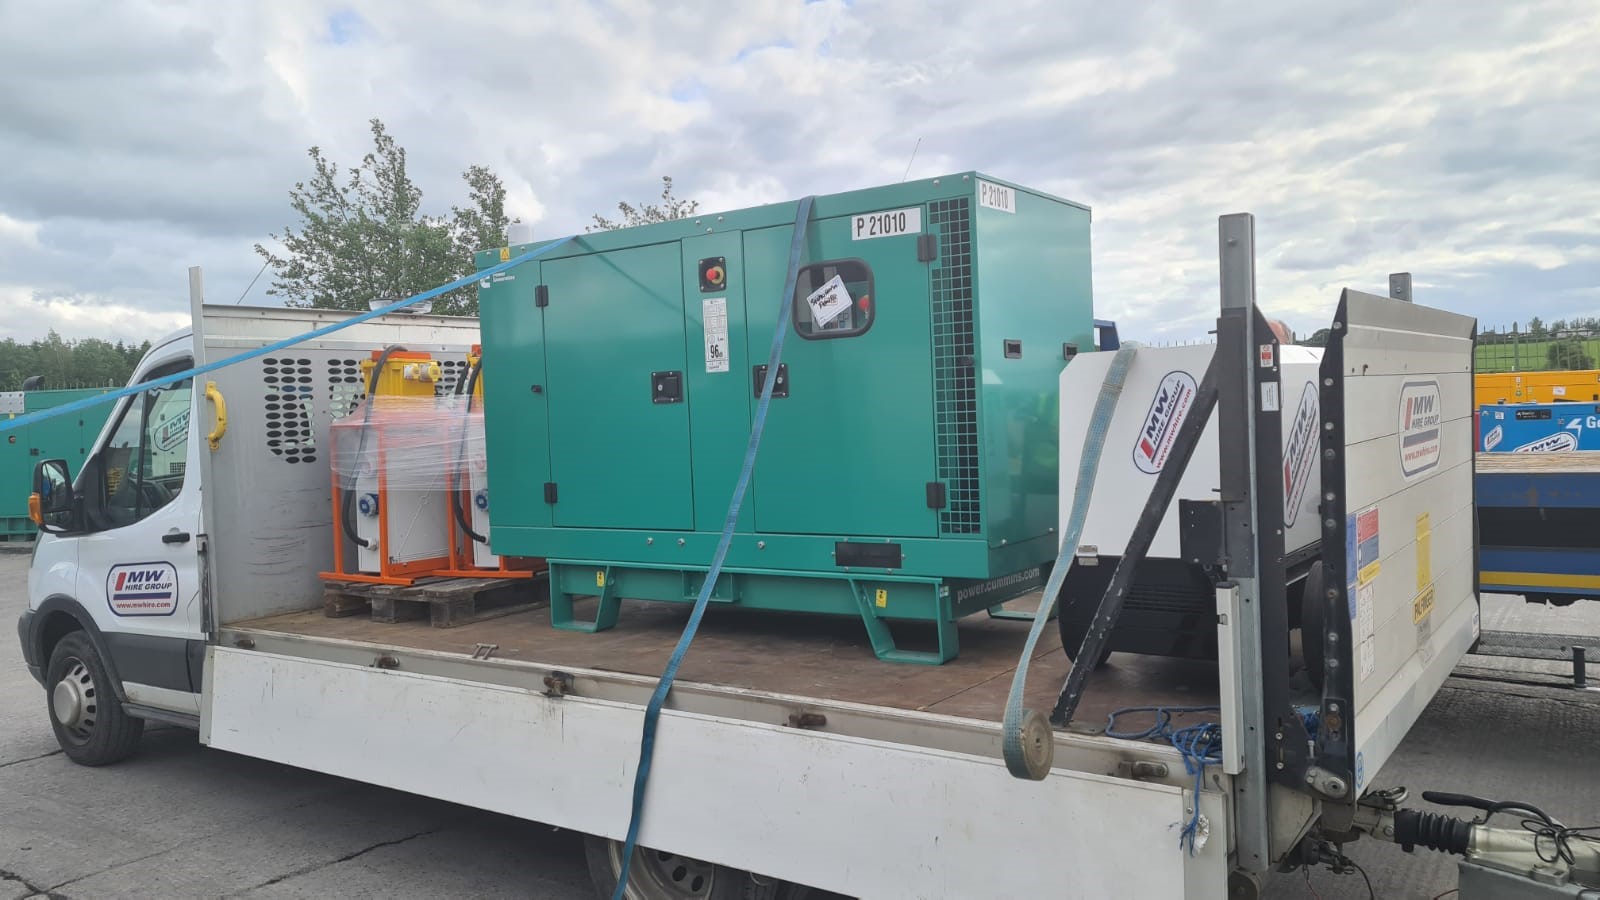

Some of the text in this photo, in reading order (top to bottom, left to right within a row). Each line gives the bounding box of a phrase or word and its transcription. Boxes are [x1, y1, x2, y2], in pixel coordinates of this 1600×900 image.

[982, 183, 1008, 208] P 21010
[857, 211, 906, 237] P 21010
[710, 344, 719, 359] 96
[1146, 387, 1169, 440] MW
[1153, 379, 1181, 445] HIRE GROUP
[1413, 395, 1434, 415] MW
[1156, 388, 1192, 468] www.mwhire.com
[1412, 415, 1440, 429] HIRE GROUP
[1531, 438, 1560, 452] MW
[125, 582, 172, 591] HIRE GROUP
[127, 570, 165, 583] MW
[957, 567, 1040, 604] power.cummins.com
